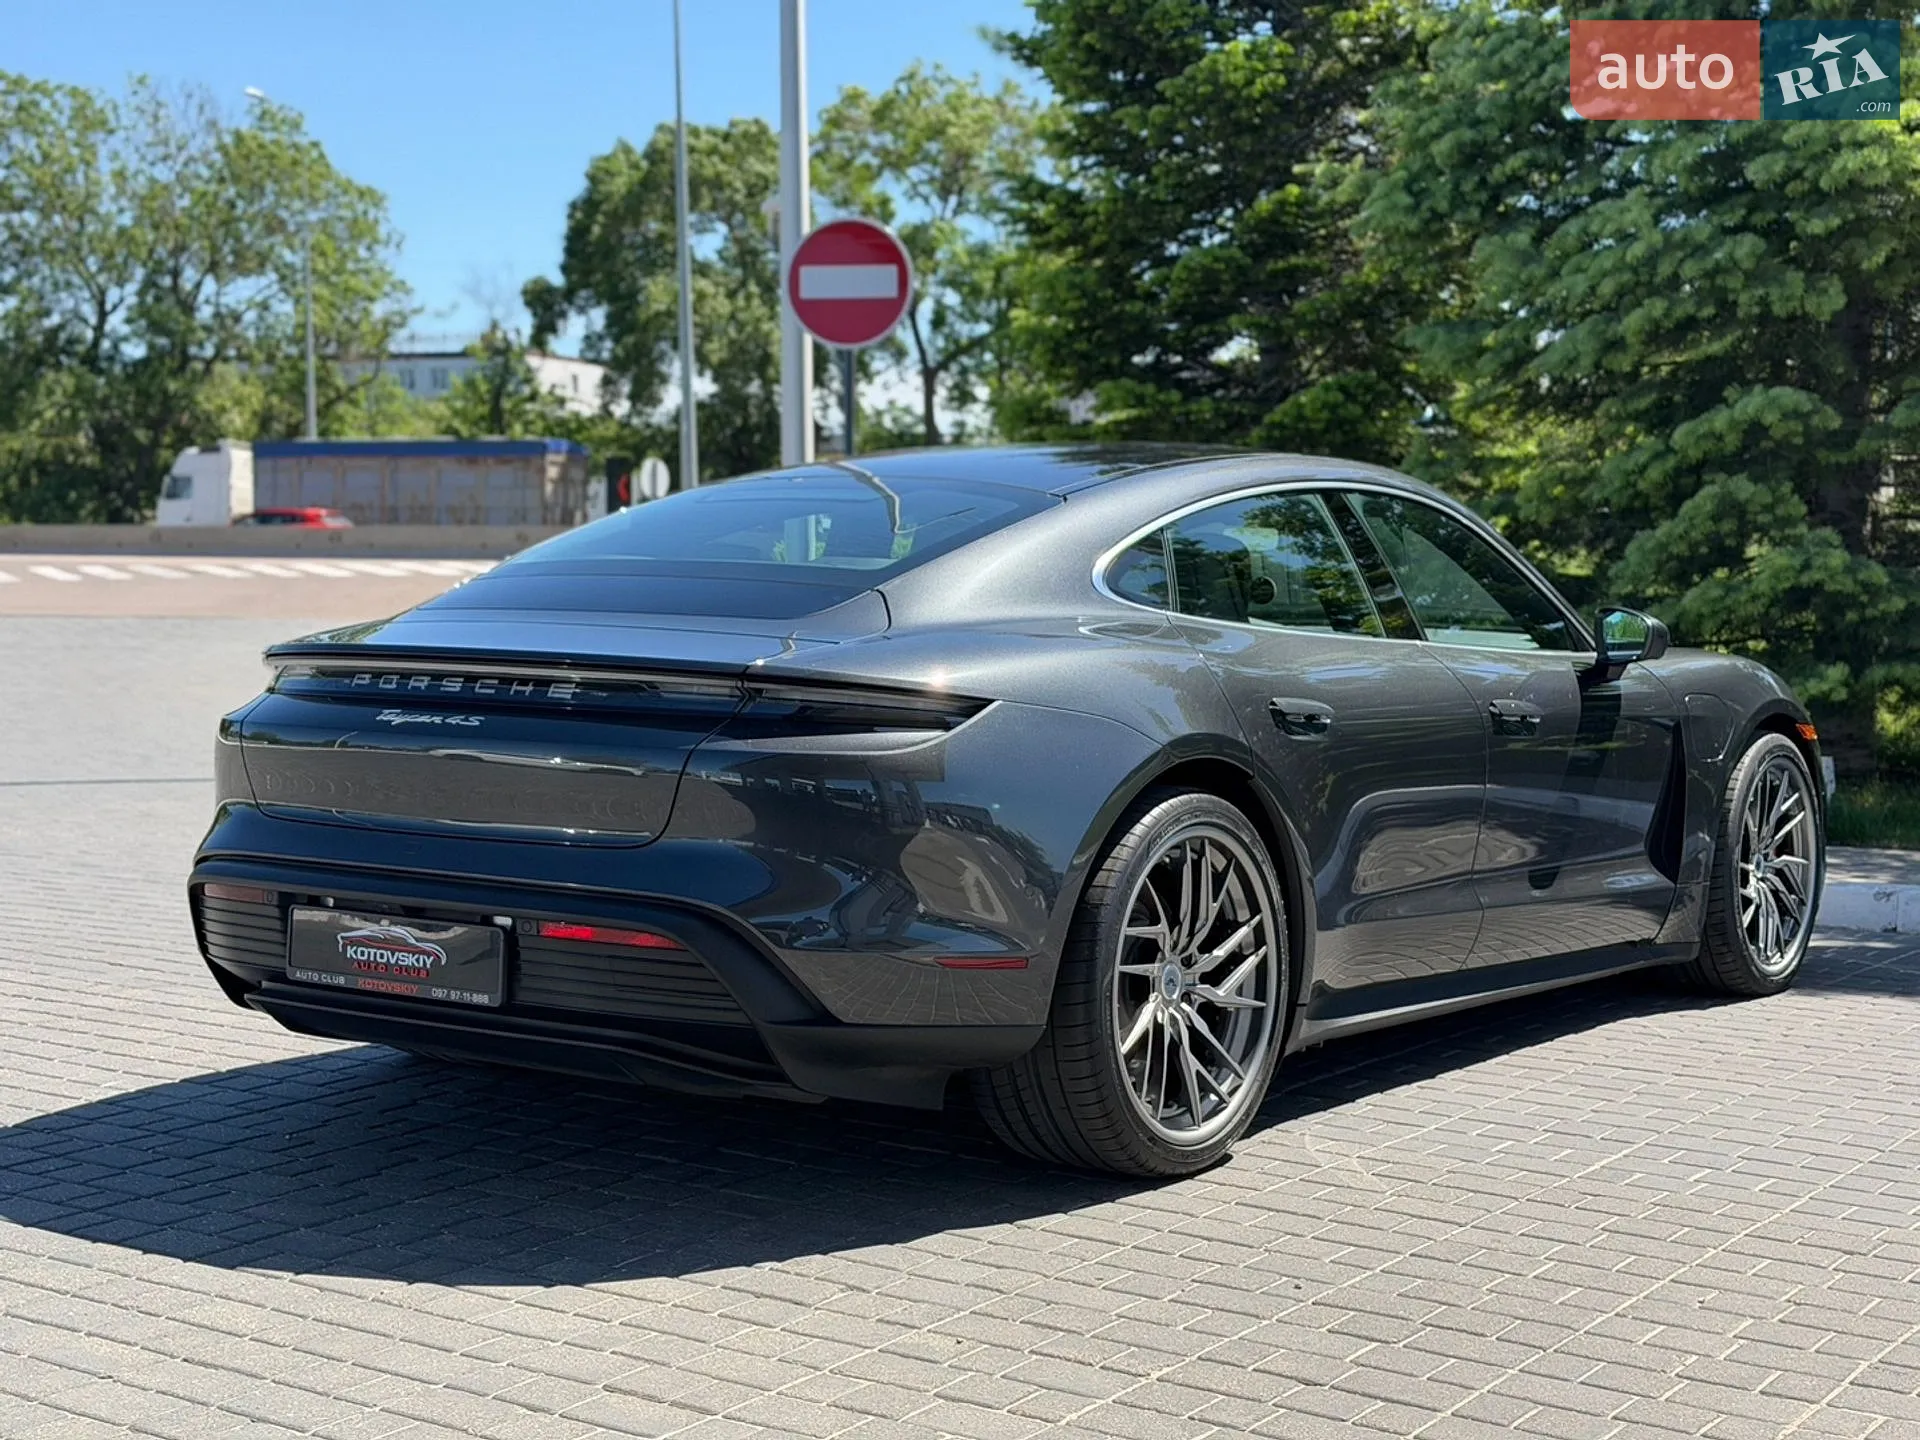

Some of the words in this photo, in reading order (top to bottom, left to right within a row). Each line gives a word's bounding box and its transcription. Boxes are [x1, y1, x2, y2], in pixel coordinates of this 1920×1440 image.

[352, 673, 577, 699] PORSCHE
[376, 709, 443, 726] Taycan
[444, 715, 486, 726] 4S
[346, 945, 434, 969] KOTOVSKIY
[295, 970, 319, 981] AUTO
[321, 973, 345, 985] CLUB
[352, 962, 387, 972] AUTO
[393, 966, 428, 977] CLUB
[357, 978, 419, 993] KOTOVSKIY
